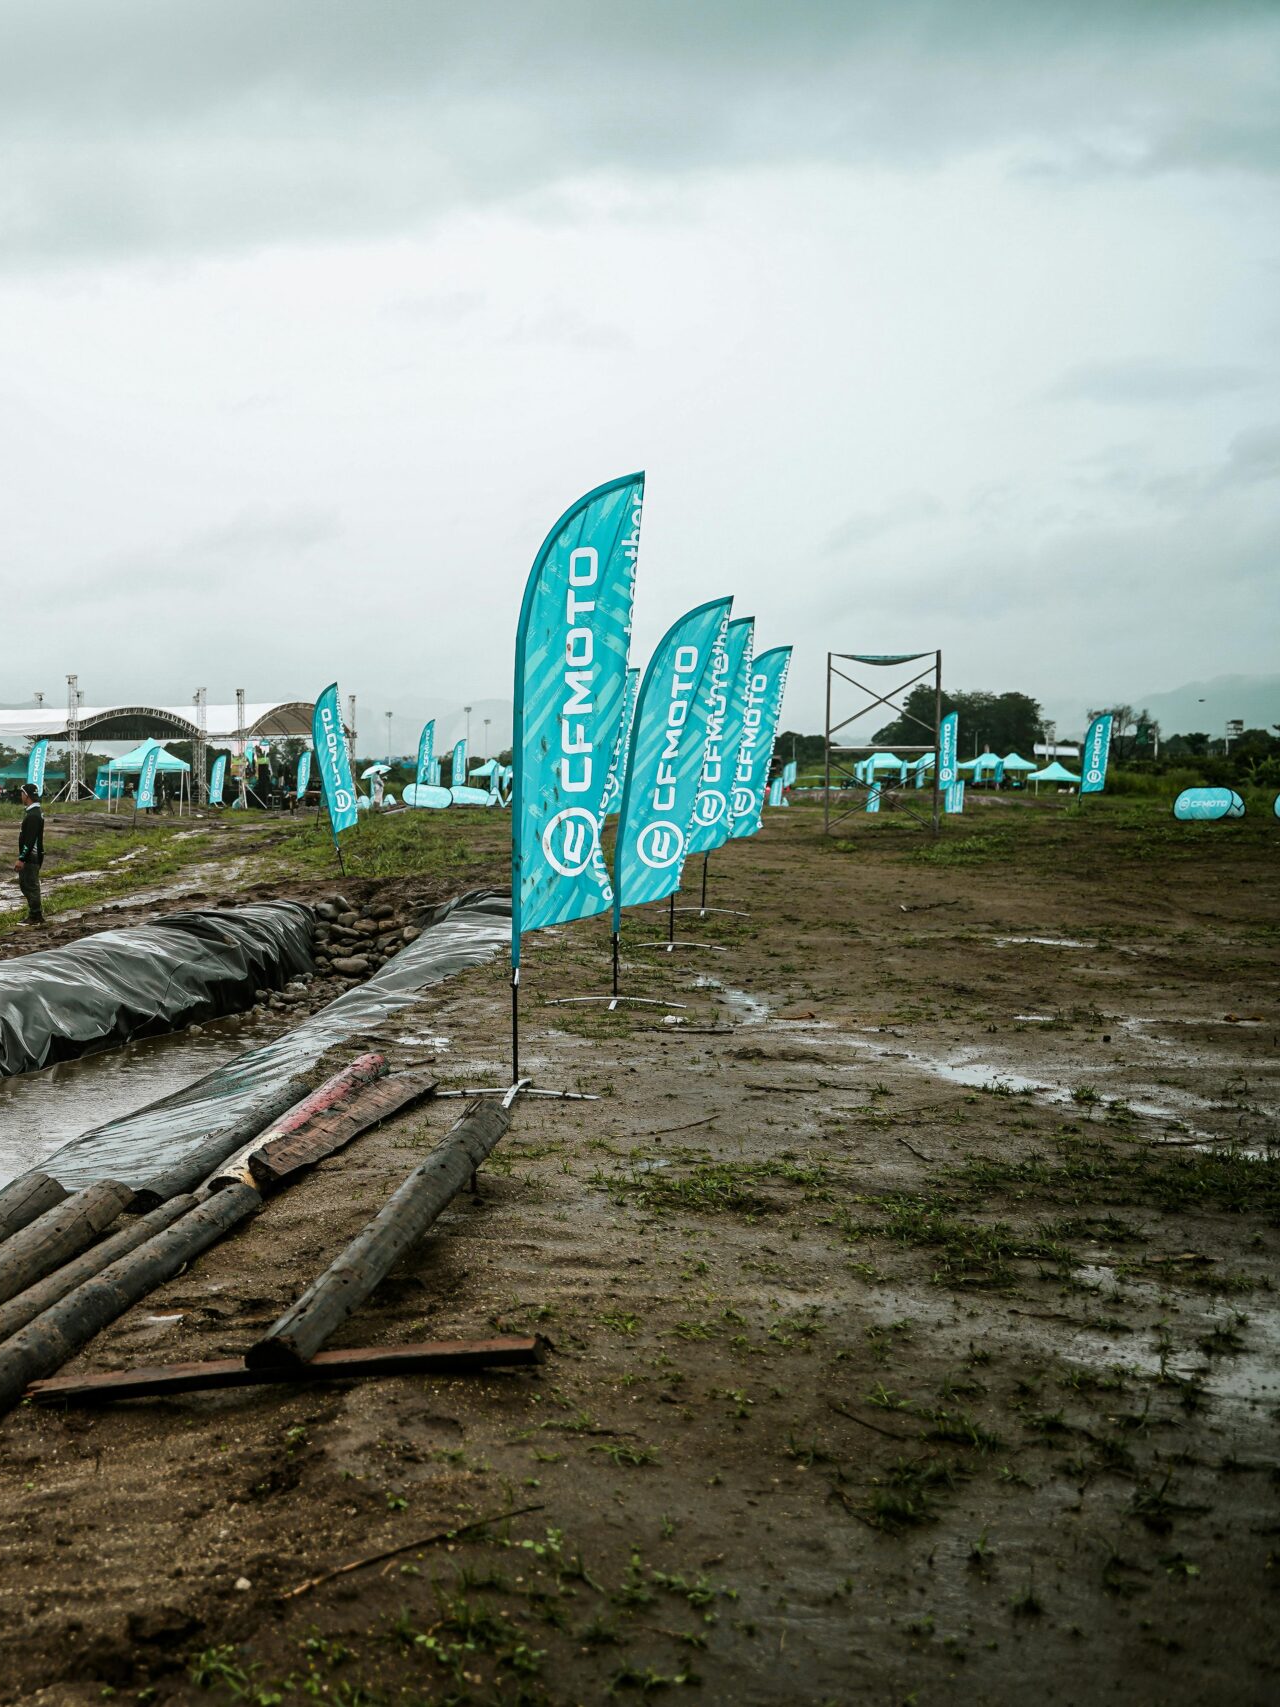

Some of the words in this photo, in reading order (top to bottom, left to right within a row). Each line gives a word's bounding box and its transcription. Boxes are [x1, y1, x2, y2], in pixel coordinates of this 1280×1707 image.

[561, 546, 599, 793] CFMOTO
[653, 646, 698, 811] CFMOTO
[736, 674, 768, 781] CFMOTO
[943, 723, 951, 767] CFMOTO
[1091, 724, 1104, 769] CFMOTO
[1190, 799, 1228, 808] CFMOTO
